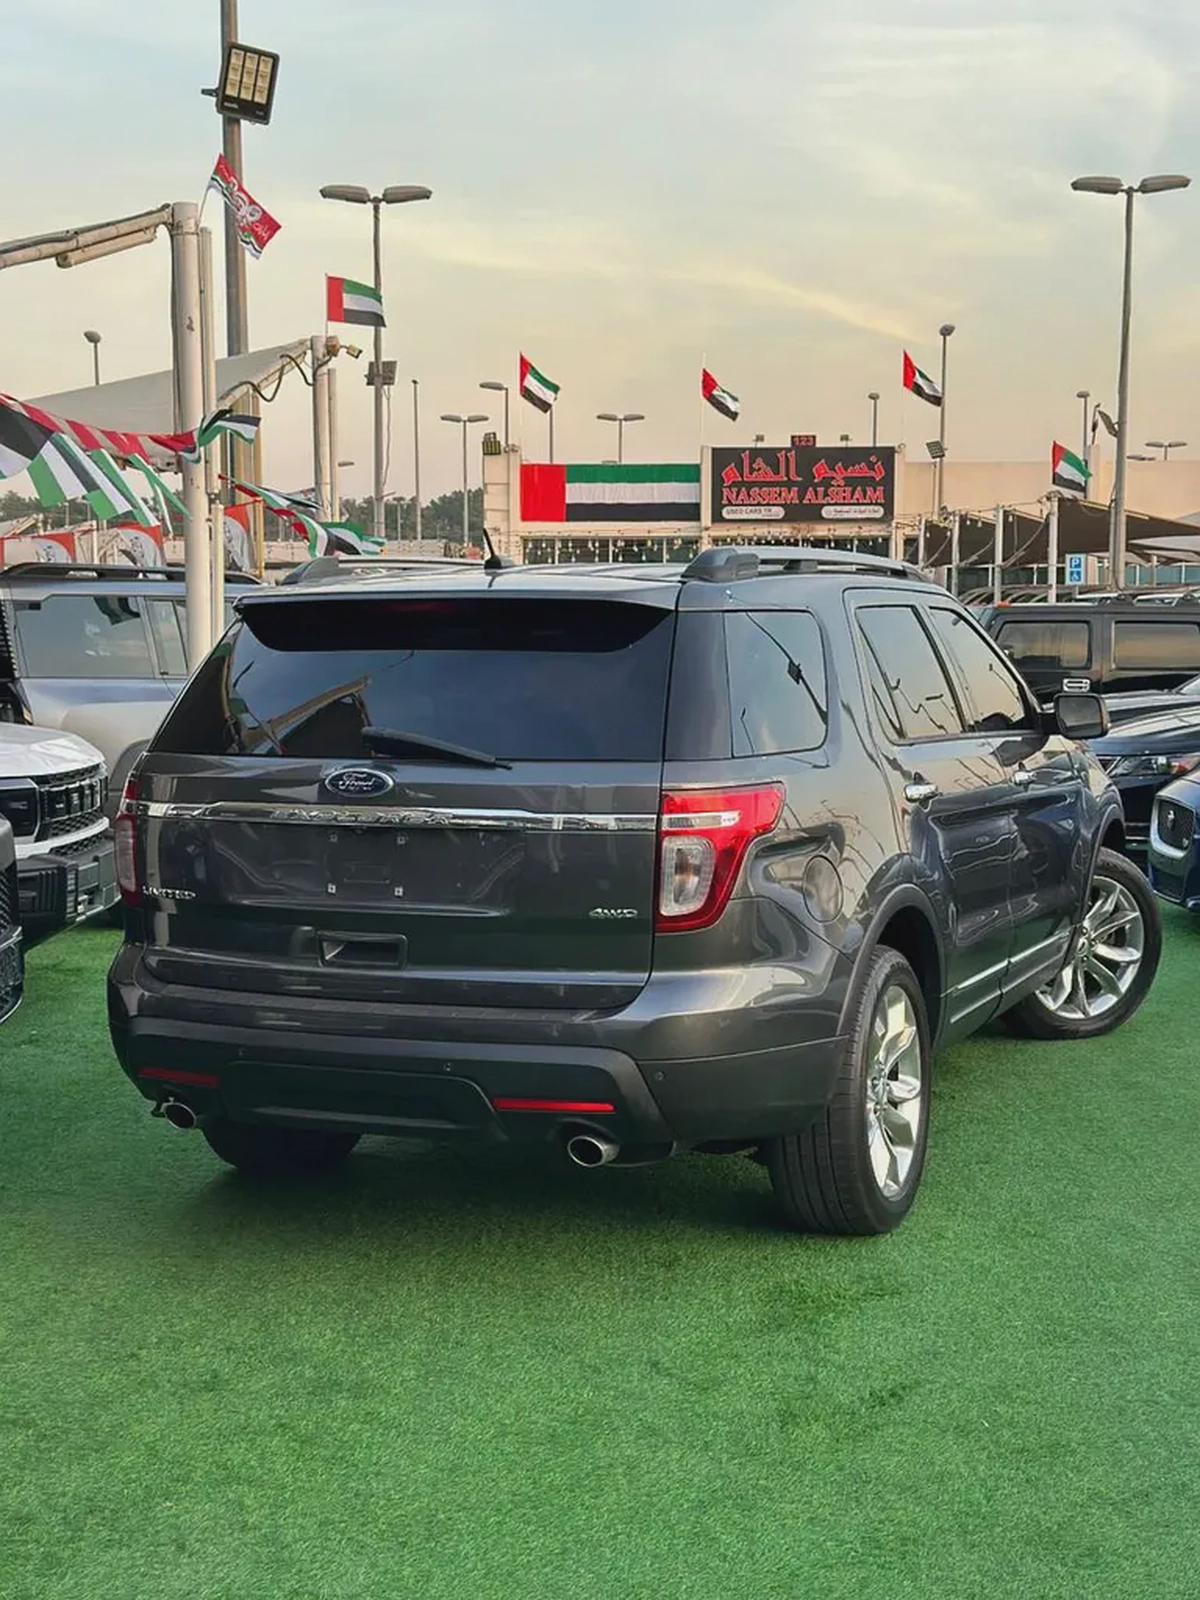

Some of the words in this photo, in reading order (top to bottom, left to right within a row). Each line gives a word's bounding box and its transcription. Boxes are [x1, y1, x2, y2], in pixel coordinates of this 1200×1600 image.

[793, 436, 815, 446] 123
[721, 449, 803, 487] الشام
[812, 455, 885, 487] نسيم
[721, 486, 800, 505] NASSEM
[802, 486, 885, 504] ALSHAM
[1071, 558, 1080, 569] P
[338, 772, 376, 790] Ford
[588, 907, 638, 919] 4WD
